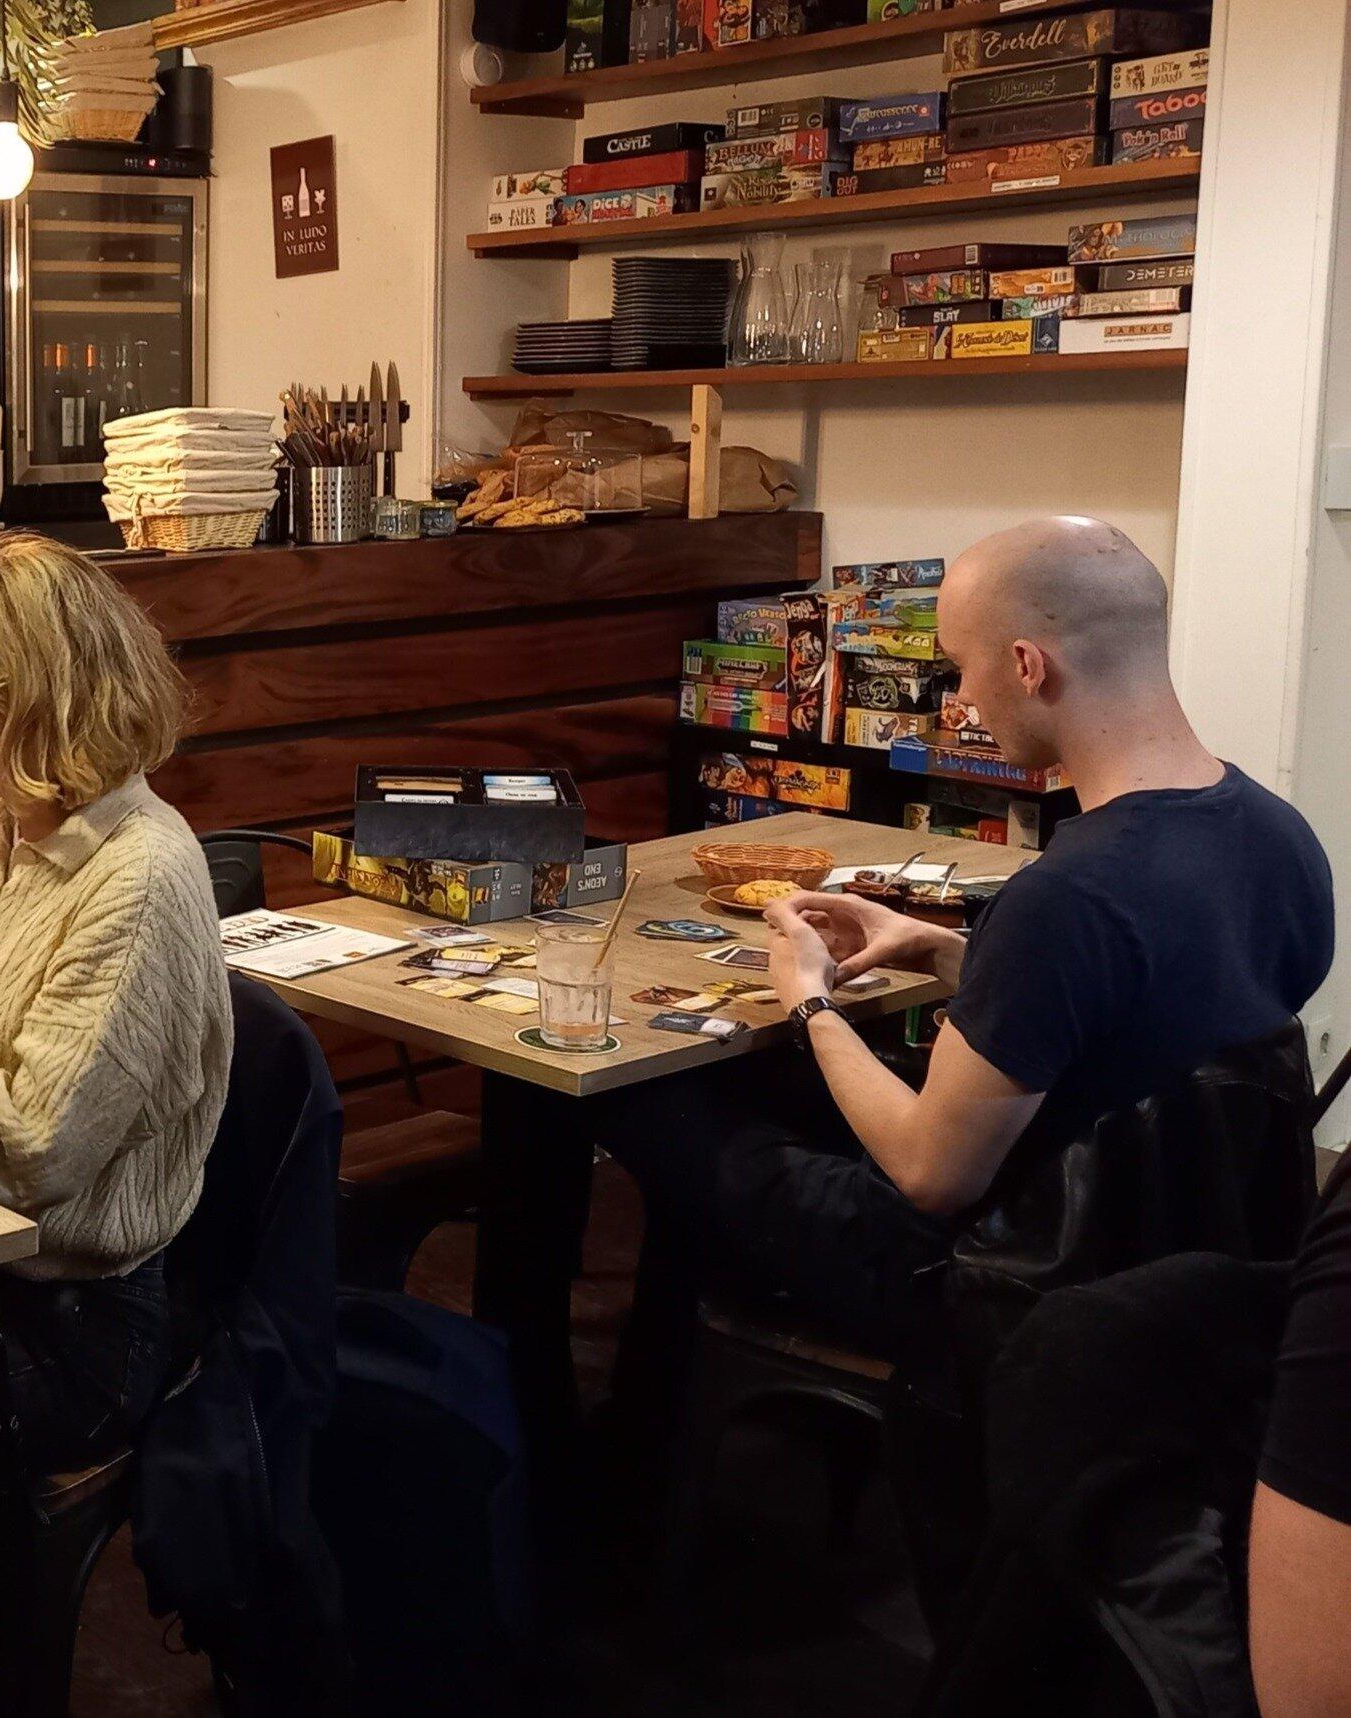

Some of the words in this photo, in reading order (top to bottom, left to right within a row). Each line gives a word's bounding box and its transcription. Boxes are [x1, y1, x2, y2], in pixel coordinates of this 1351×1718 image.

[980, 18, 1066, 59] Everdell
[283, 230, 295, 243] IN
[299, 225, 328, 240] LUDO
[286, 240, 327, 256] VERITAS
[1126, 265, 1193, 282] DEMETER
[1106, 324, 1172, 335] JARNAC
[584, 862, 602, 876] END
[577, 875, 607, 892] AEON'S
